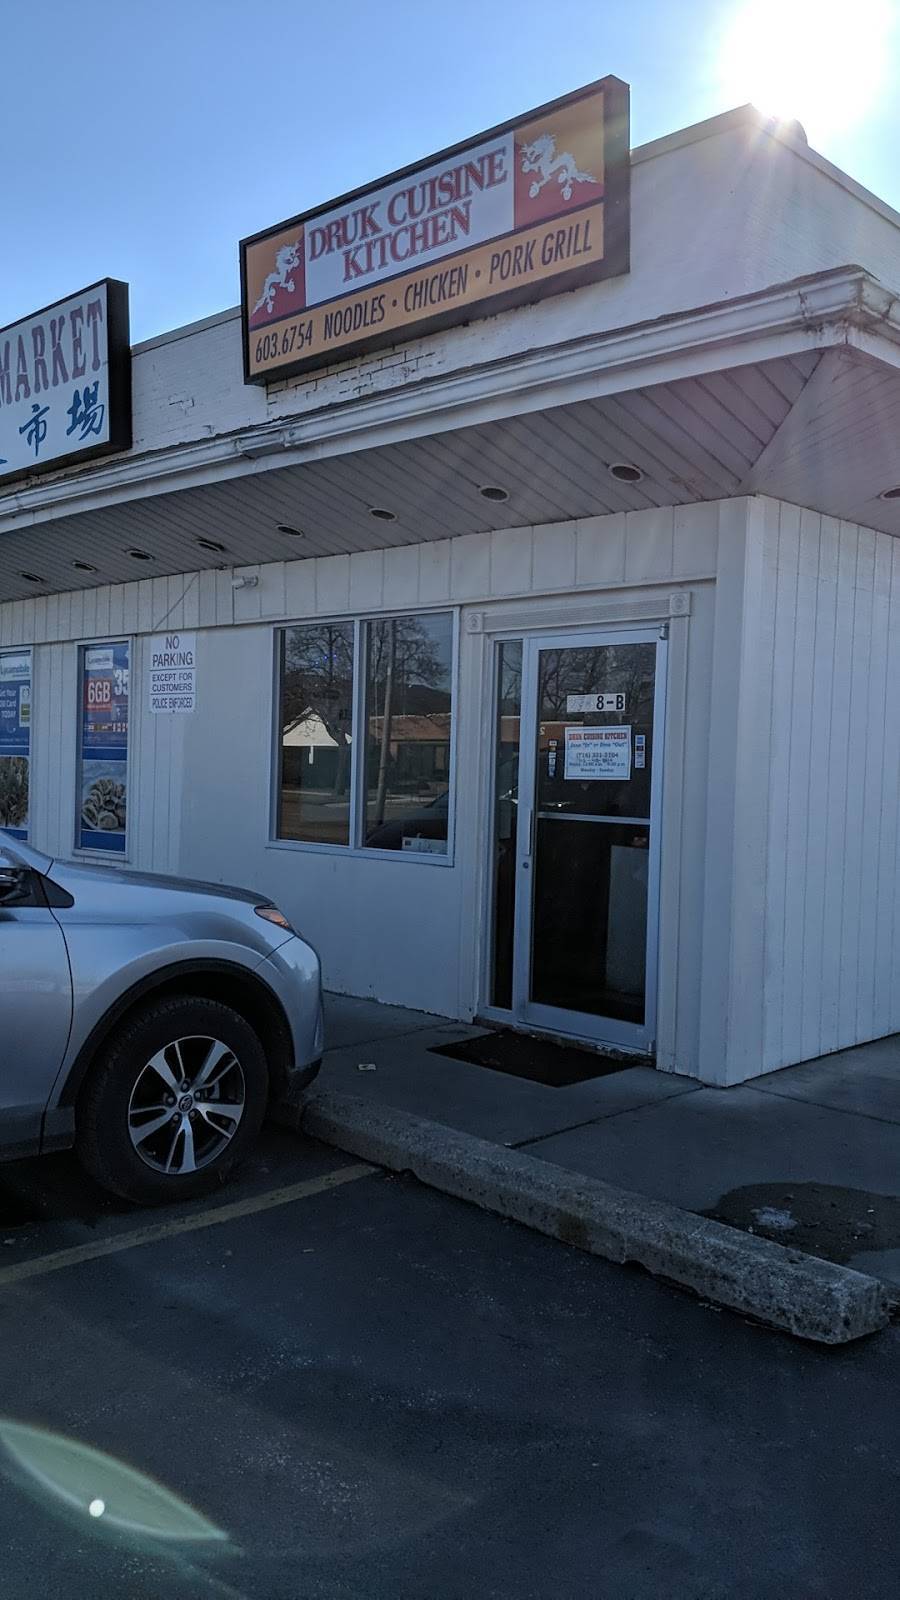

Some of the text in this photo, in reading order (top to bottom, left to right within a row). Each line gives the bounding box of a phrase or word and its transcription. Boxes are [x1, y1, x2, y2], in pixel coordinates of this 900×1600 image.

[308, 147, 508, 261] DRUK CUISINE
[342, 200, 472, 283] KITCHEN
[255, 219, 593, 363] 603.6754 NOODLES CHICKEN PORK GRILL
[0, 380, 105, 464] 市場
[165, 635, 180, 650] NO
[152, 651, 193, 668] PARKING
[152, 672, 193, 682] EXCEPT FOR
[152, 683, 193, 692] CUSTOMERS
[88, 681, 111, 703] 6GB
